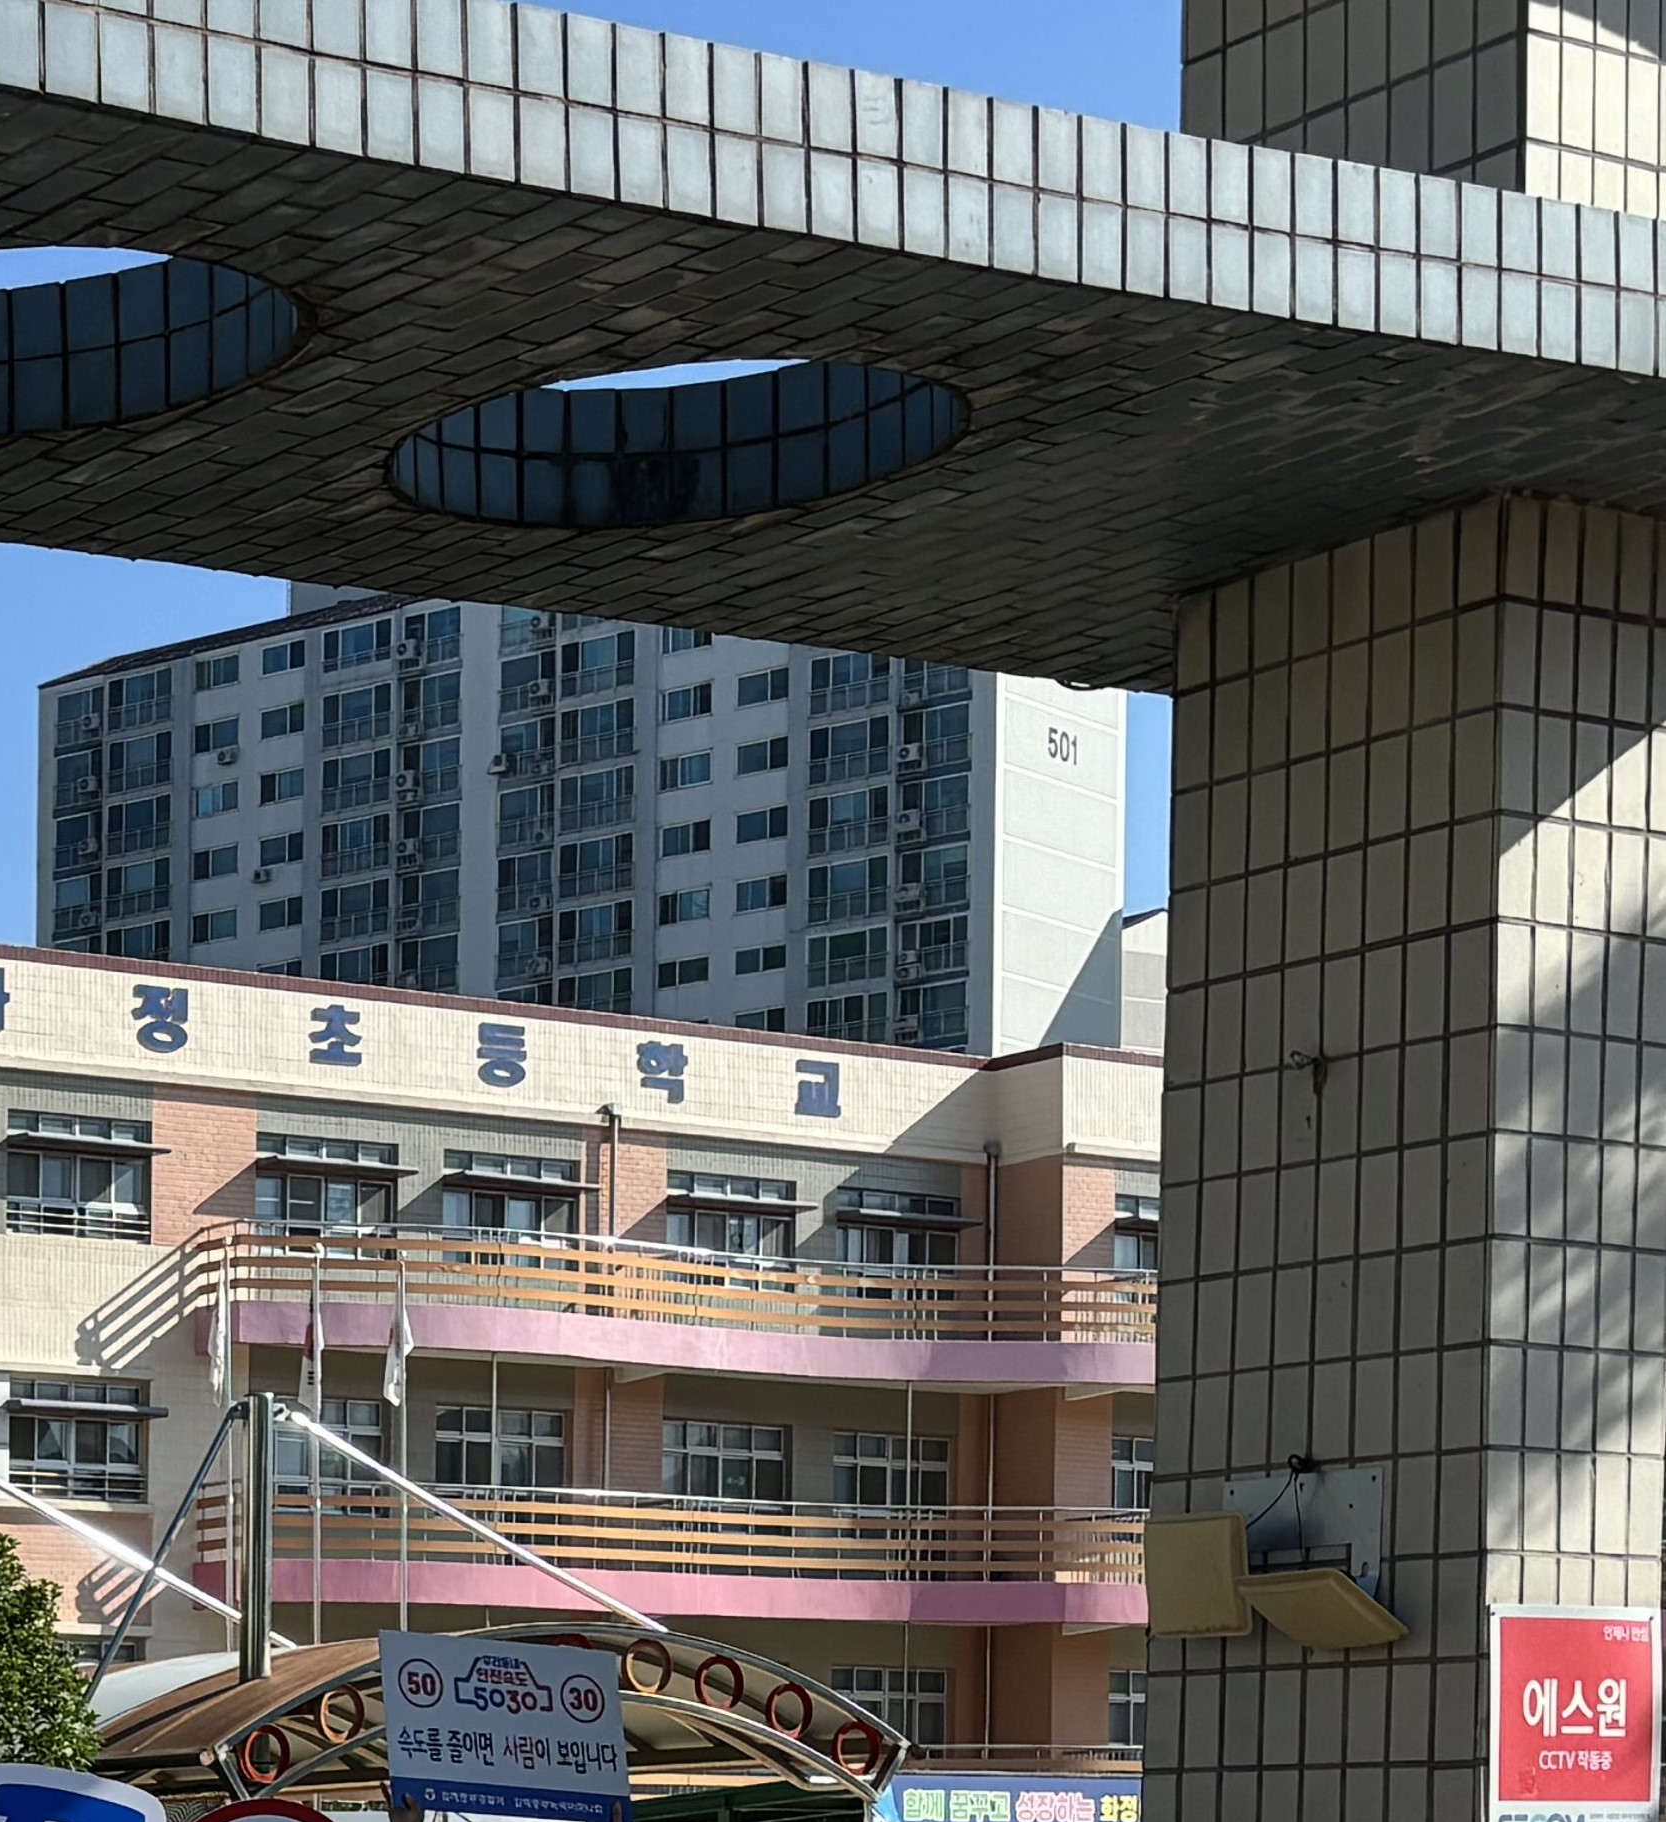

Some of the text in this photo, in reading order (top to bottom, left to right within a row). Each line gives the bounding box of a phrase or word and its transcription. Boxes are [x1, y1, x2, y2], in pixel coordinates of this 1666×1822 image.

[1048, 727, 1077, 766] 501
[407, 1671, 436, 1697] 50
[474, 1687, 536, 1715] 5030
[569, 1688, 598, 1712] 30
[1523, 1678, 1627, 1738] 에스원
[398, 1727, 617, 1774] 속도를 줄이면 사람이 보입니다
[1539, 1751, 1613, 1771] CCTV 작동중
[903, 1789, 945, 1822] 함께
[950, 1790, 1011, 1822] 꿈꾸고
